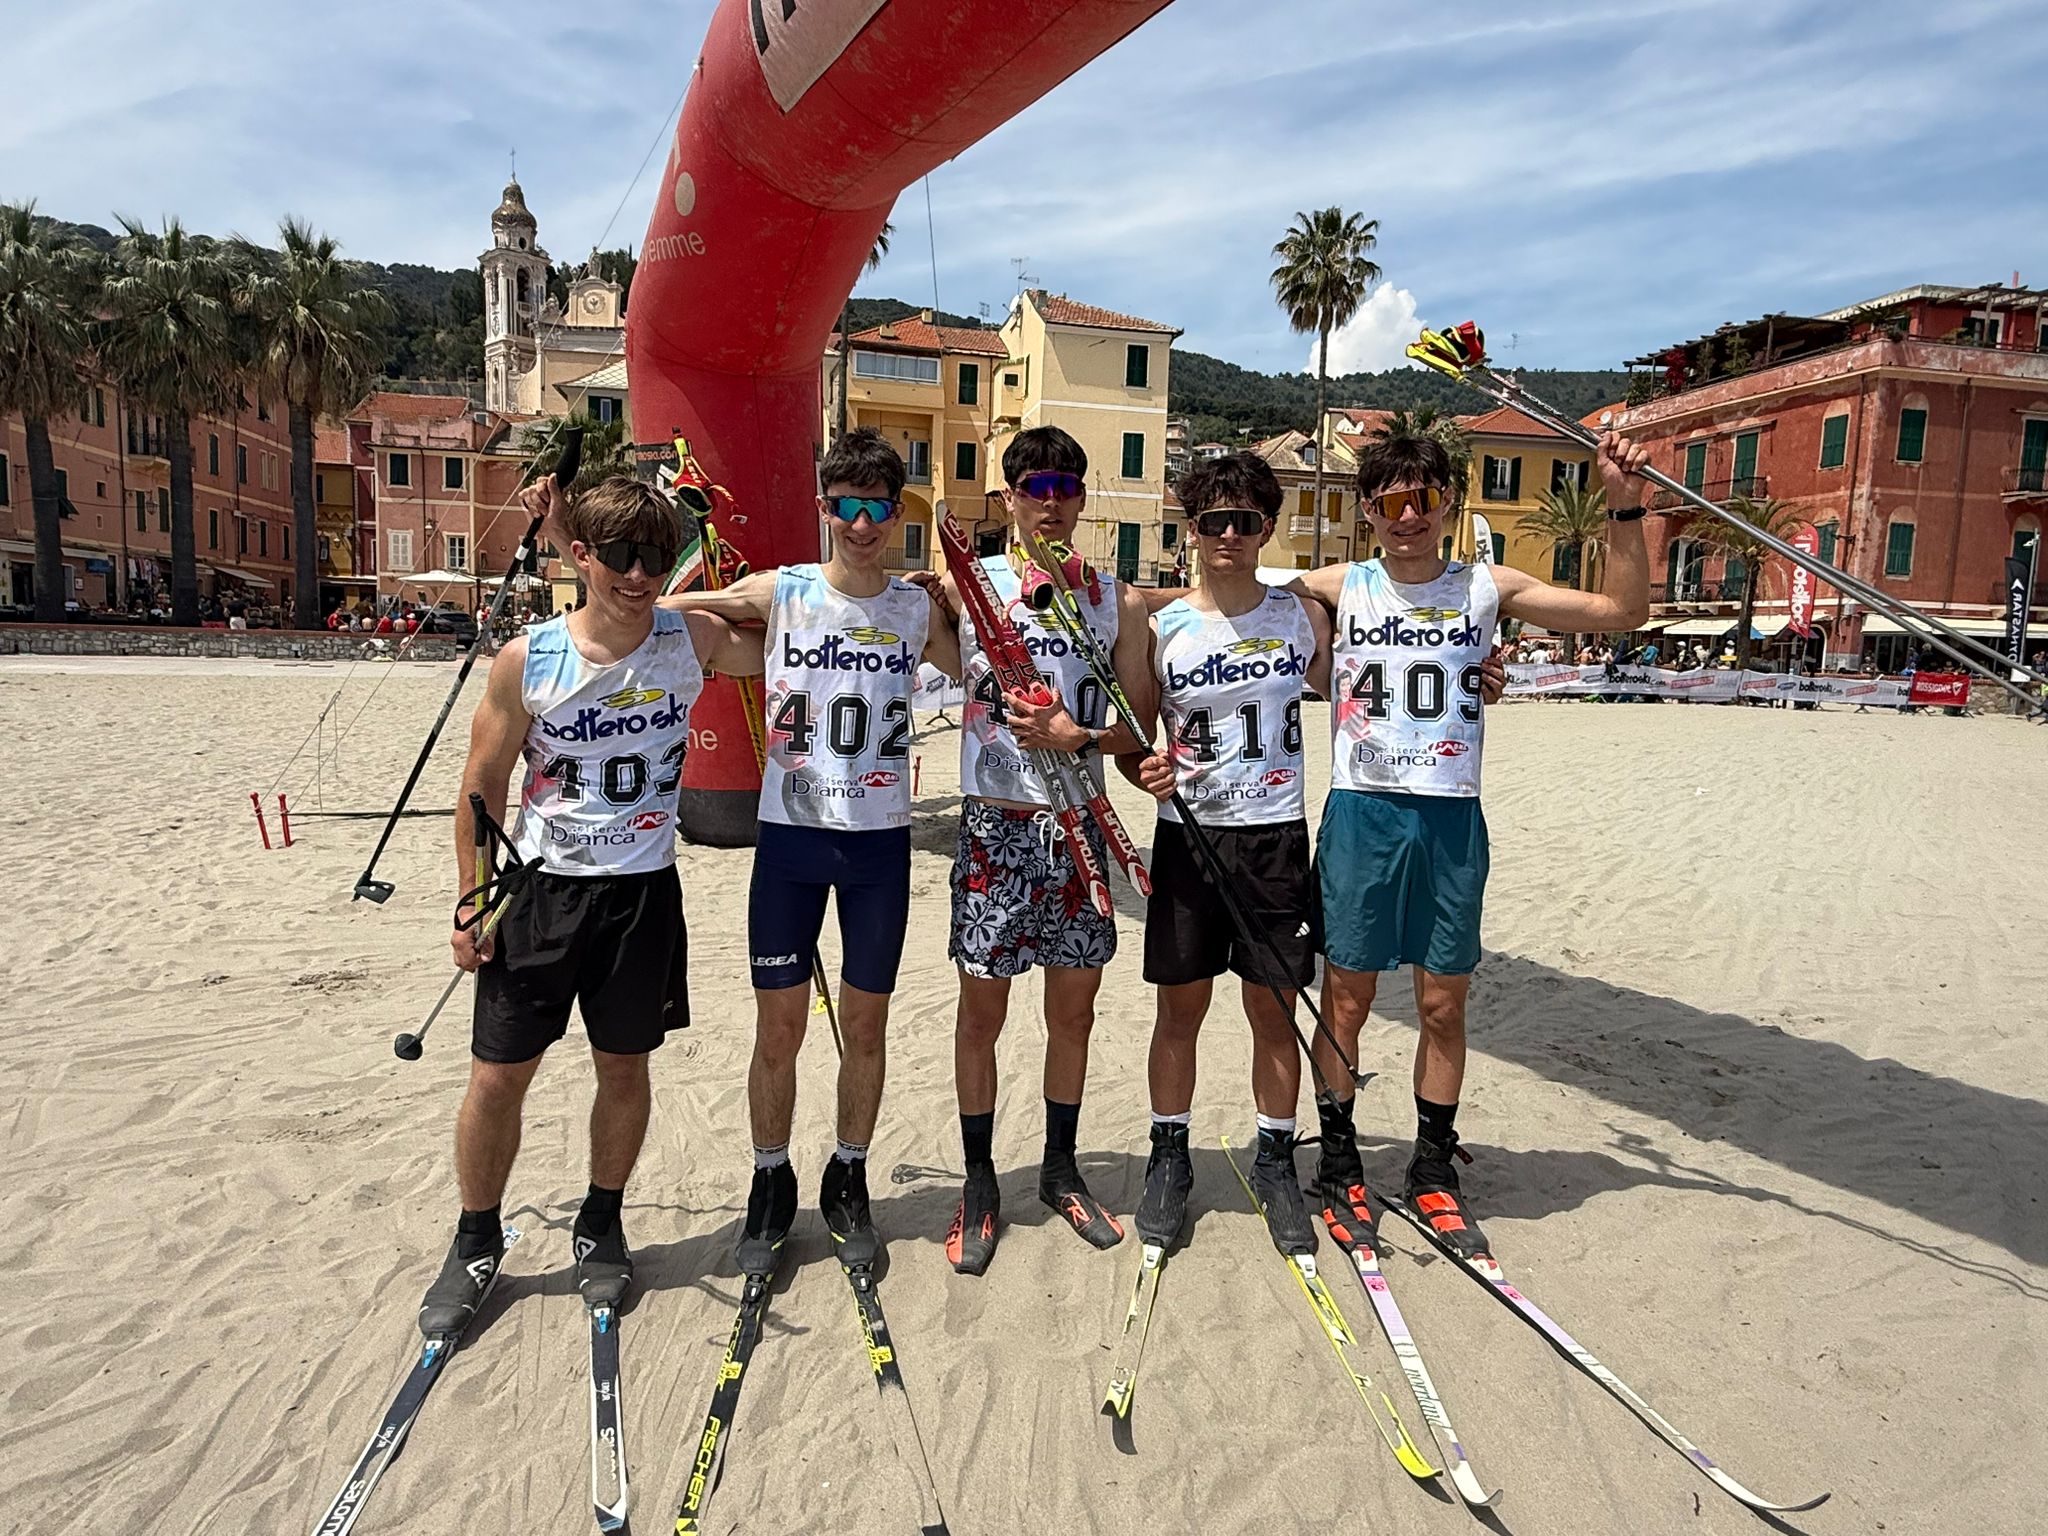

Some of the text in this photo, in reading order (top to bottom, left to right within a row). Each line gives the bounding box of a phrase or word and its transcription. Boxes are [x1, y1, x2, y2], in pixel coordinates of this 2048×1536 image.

[1350, 615, 1444, 647] bottero
[784, 633, 883, 673] bottero
[1167, 653, 1271, 691] bottero
[1350, 659, 1482, 724] 409
[772, 690, 910, 760] 402
[1177, 697, 1301, 765] 418
[542, 737, 688, 806] 403
[984, 748, 1036, 774] bian
[1357, 744, 1437, 767] bianca
[791, 773, 866, 799] bianca
[1192, 780, 1268, 801] bianca
[550, 818, 637, 846] bianca
[1071, 826, 1101, 877] XTOUR
[1103, 810, 1138, 860] XTOUR
[751, 953, 798, 967] LEGEA
[684, 1415, 721, 1511] FISCHER
